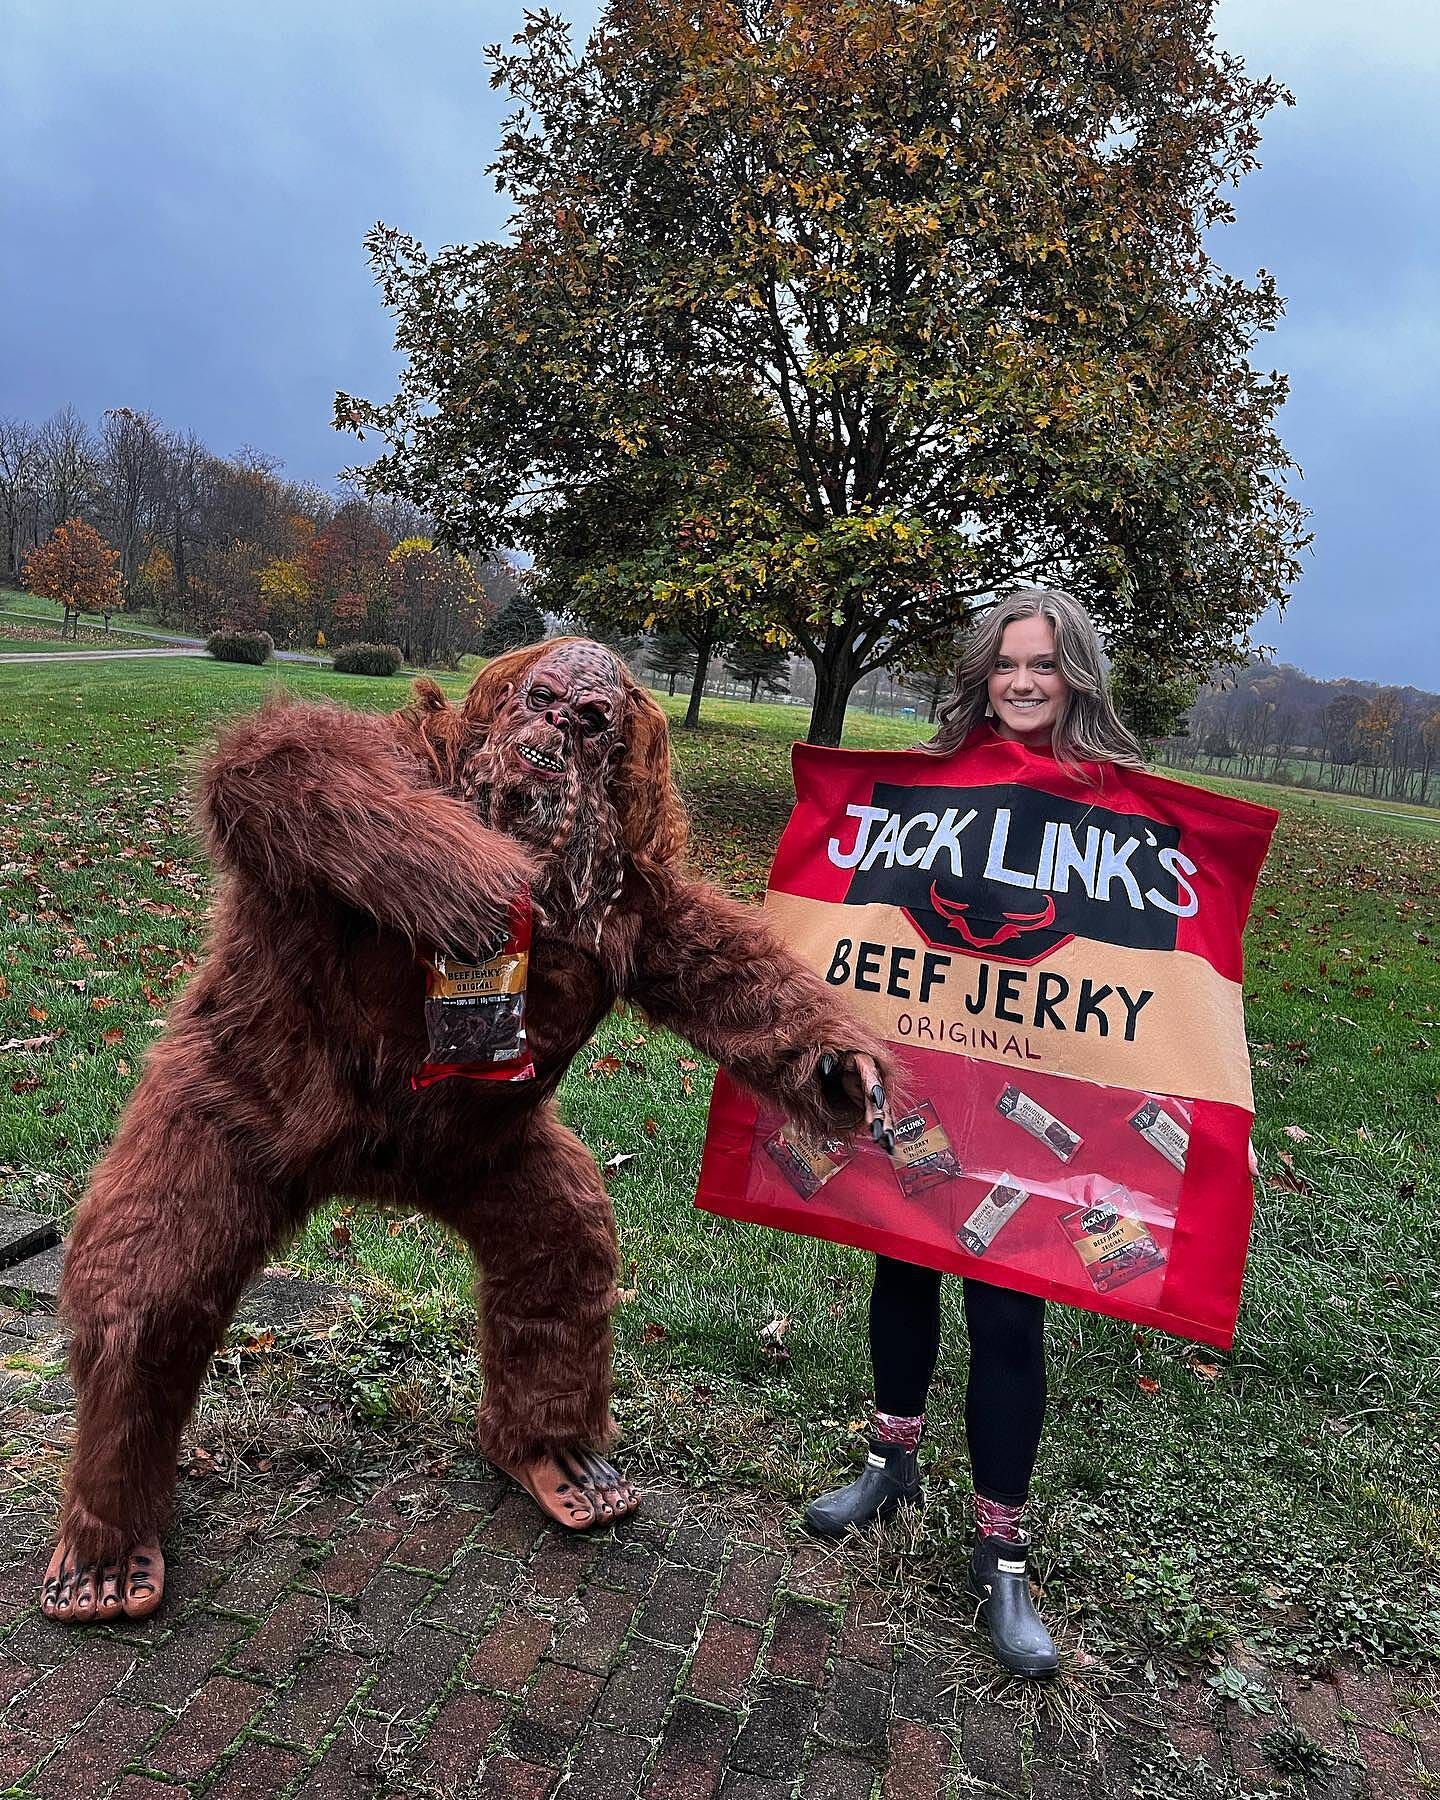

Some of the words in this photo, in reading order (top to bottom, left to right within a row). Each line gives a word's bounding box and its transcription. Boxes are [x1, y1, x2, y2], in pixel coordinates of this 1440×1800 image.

[827, 803, 978, 878] JACK
[983, 807, 1199, 918] LINK'S
[447, 970, 470, 981] BEEF
[471, 968, 501, 979] JERKY
[456, 981, 493, 991] ORIGINAL
[825, 938, 952, 1003] BEEF
[964, 963, 1154, 1042] JERKY
[897, 1013, 1042, 1060] ORIGINAL
[1161, 1121, 1186, 1146] ORIGINAL
[1080, 1216, 1100, 1231] JACK
[1092, 1236, 1107, 1248] BEEF
[1106, 1227, 1125, 1242] JERKY
